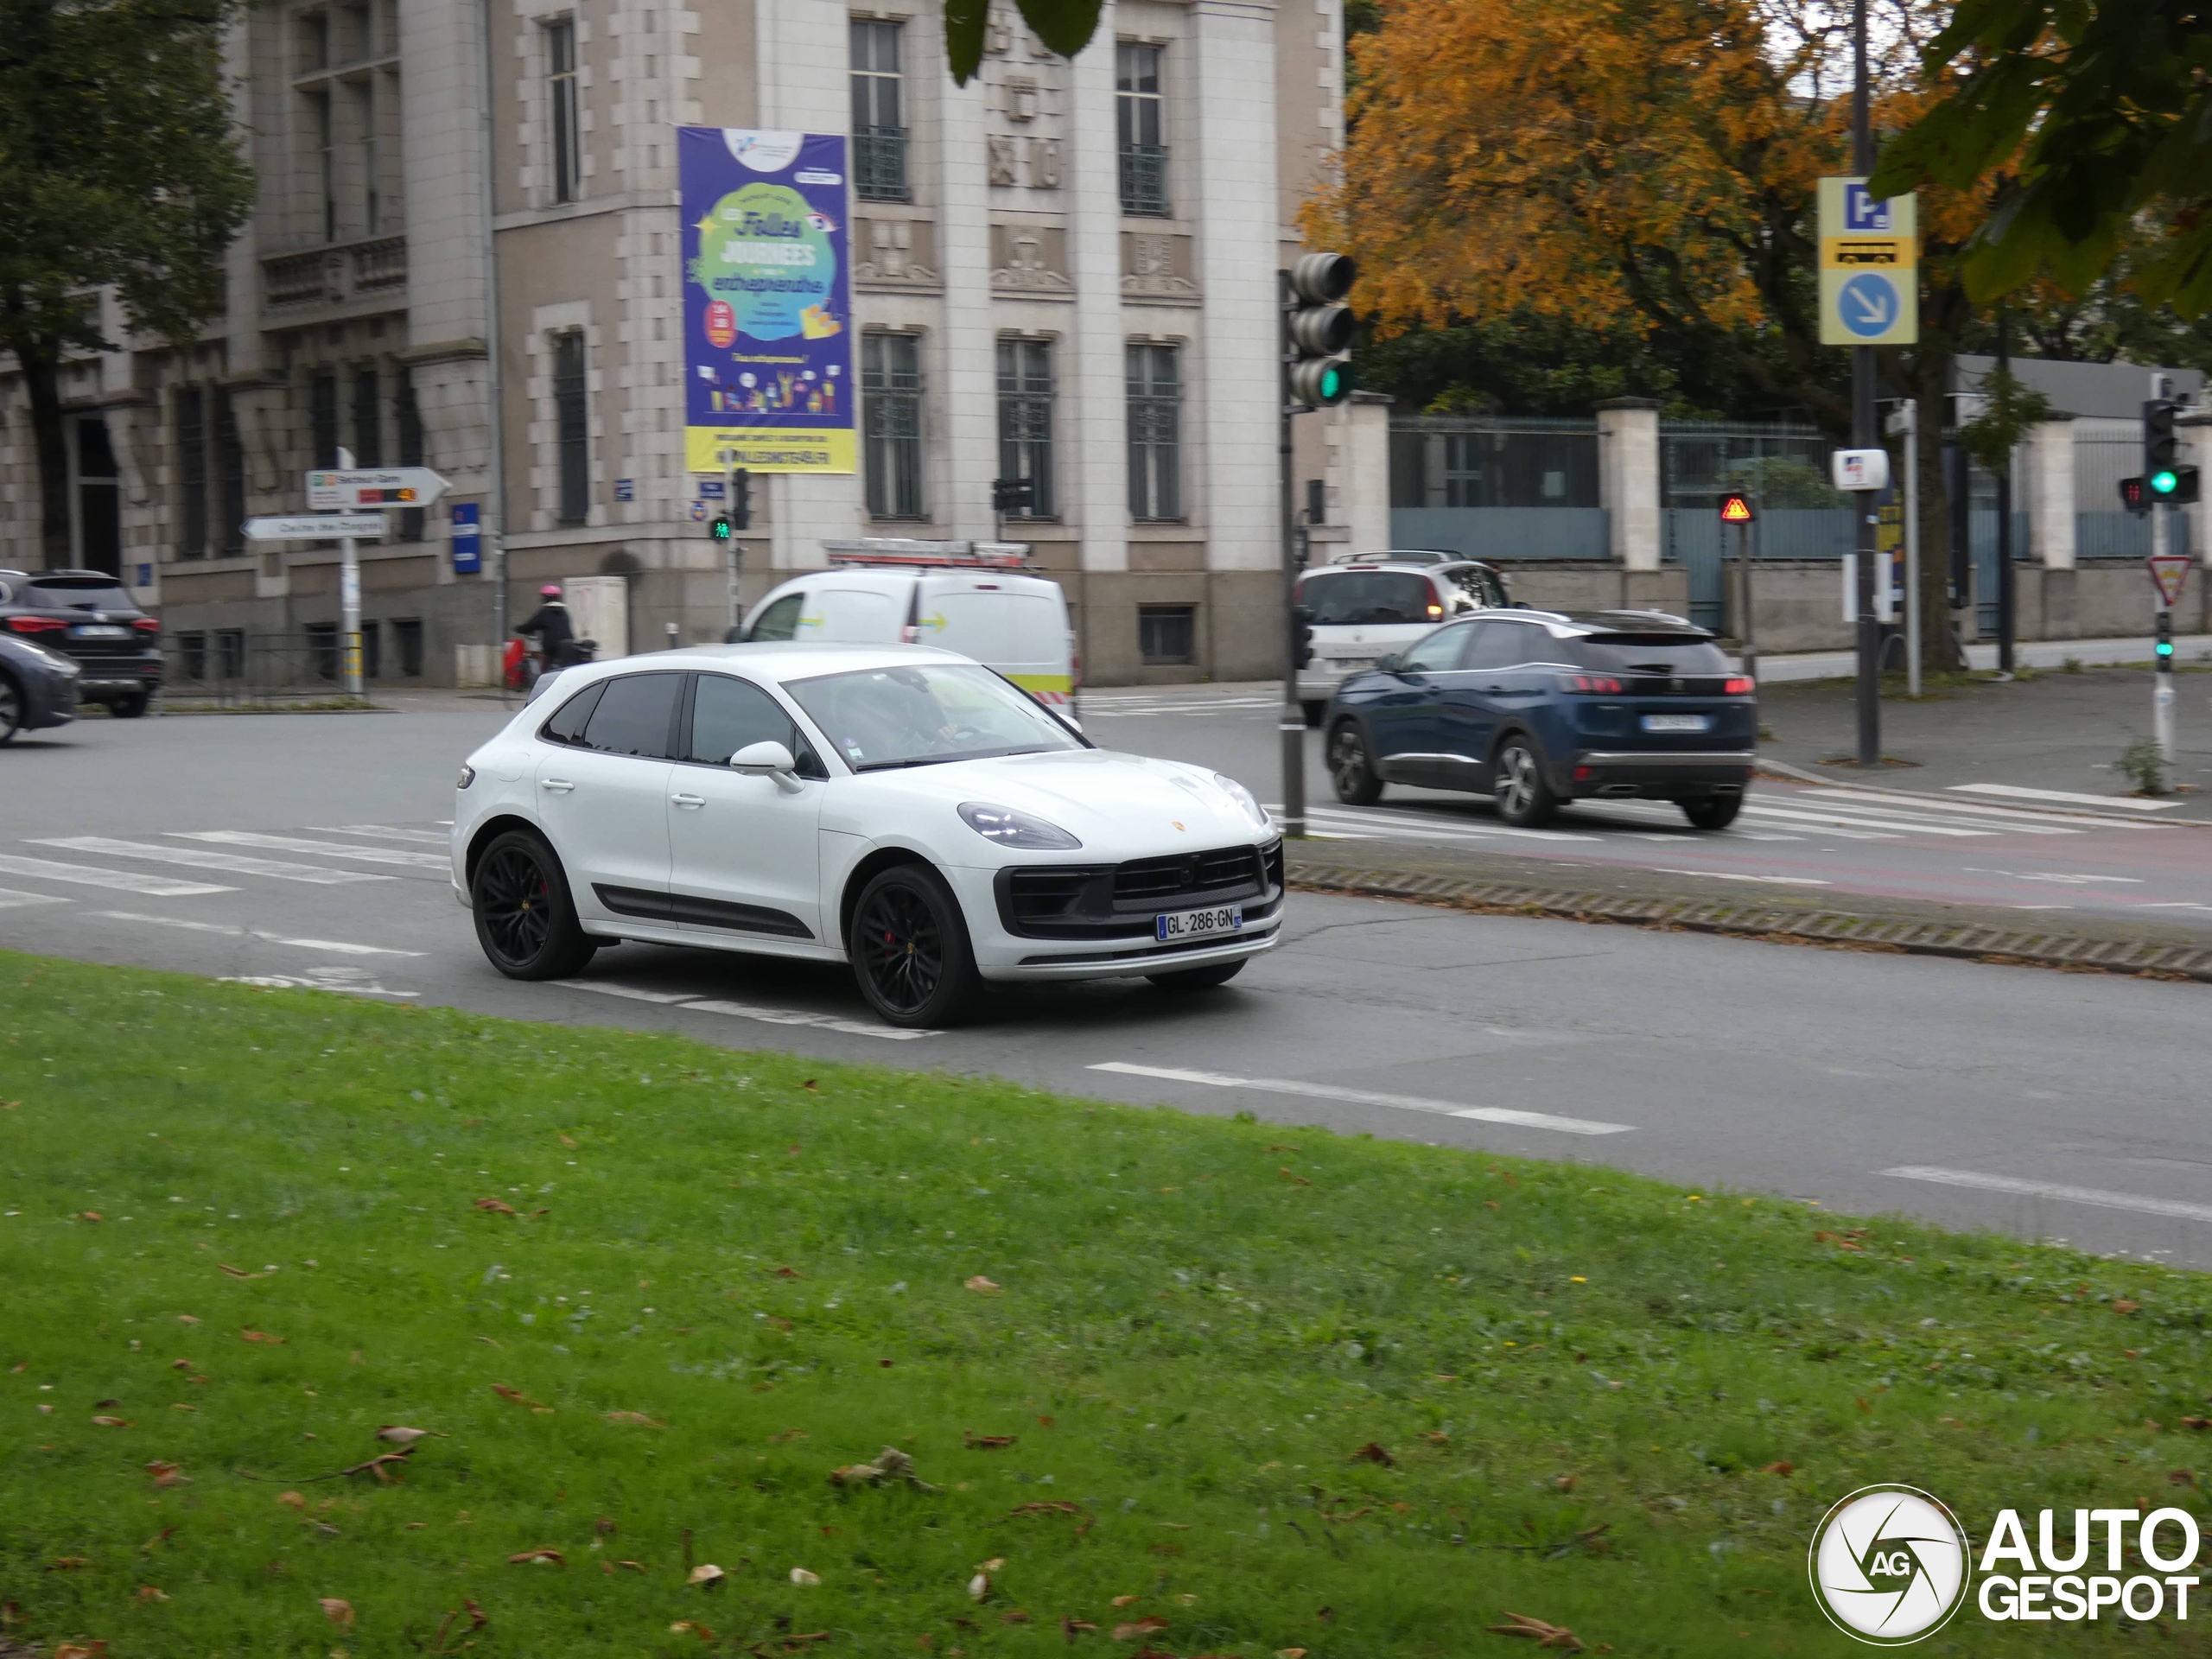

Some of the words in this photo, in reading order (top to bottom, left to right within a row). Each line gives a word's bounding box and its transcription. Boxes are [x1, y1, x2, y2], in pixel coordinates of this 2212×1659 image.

[734, 212, 802, 236] Folles
[713, 273, 824, 296] entreprendre
[337, 474, 373, 484] Secteur
[377, 474, 401, 483] Gare
[279, 522, 315, 532] Centre
[318, 522, 336, 532] des
[1167, 908, 1233, 934] GL-286-GN
